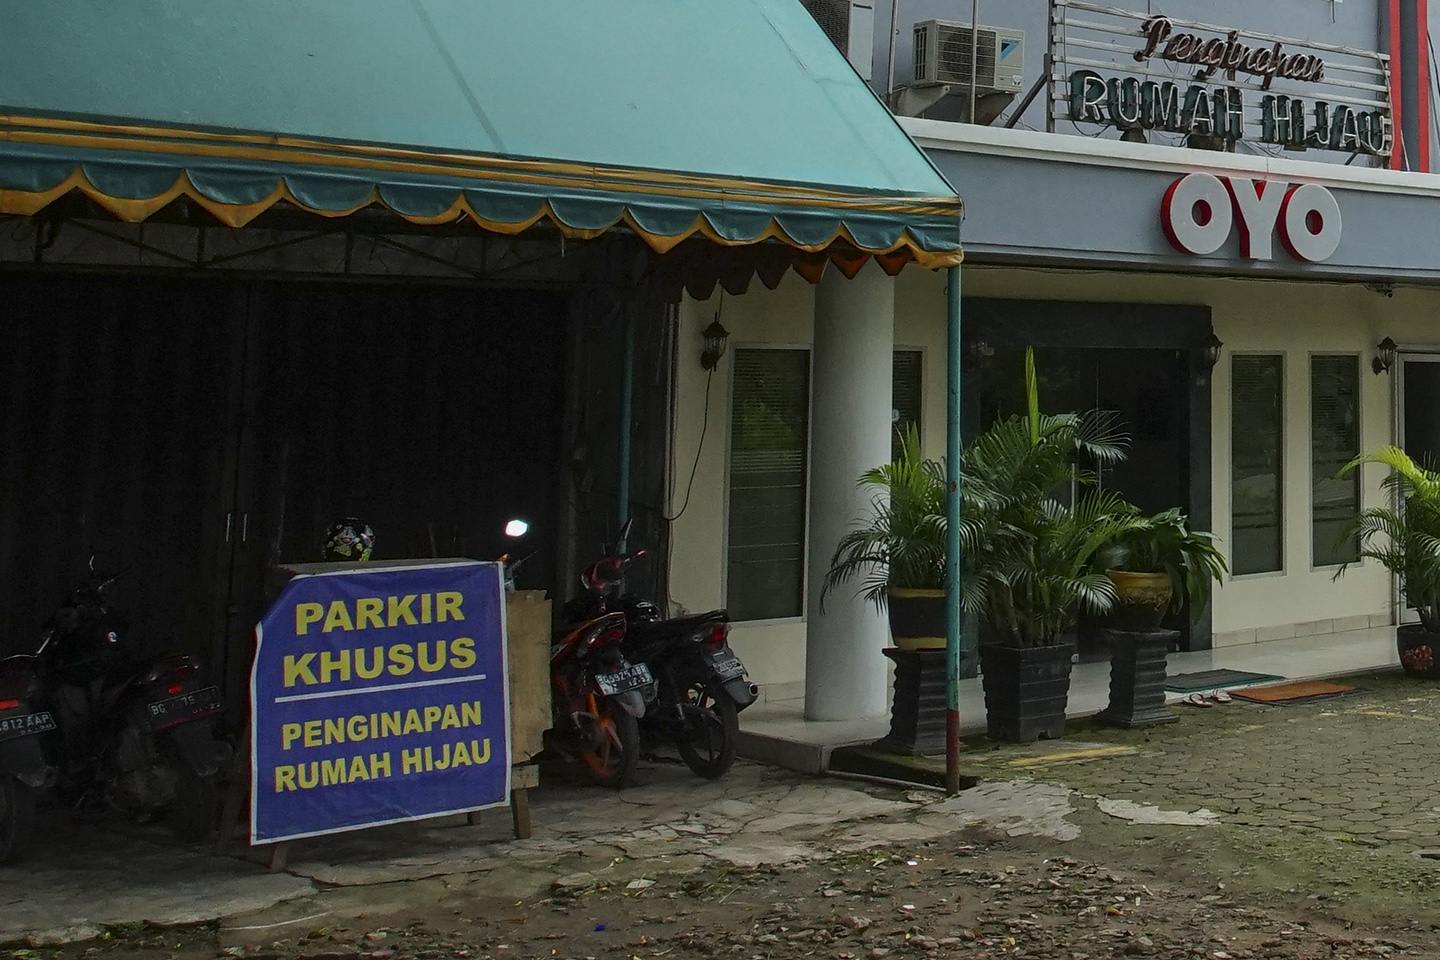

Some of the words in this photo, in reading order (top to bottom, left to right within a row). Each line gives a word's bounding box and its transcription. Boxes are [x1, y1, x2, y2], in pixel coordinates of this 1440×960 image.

[1070, 69, 1246, 139] RUMAH
[1262, 95, 1393, 156] HIJAU
[1160, 172, 1343, 262] OYO
[295, 592, 466, 636] PARKIR
[283, 637, 477, 688] KHUSUS
[281, 700, 482, 751] PENGINAPAN
[275, 751, 392, 794] RUMAH
[401, 738, 491, 776] HIJAU
